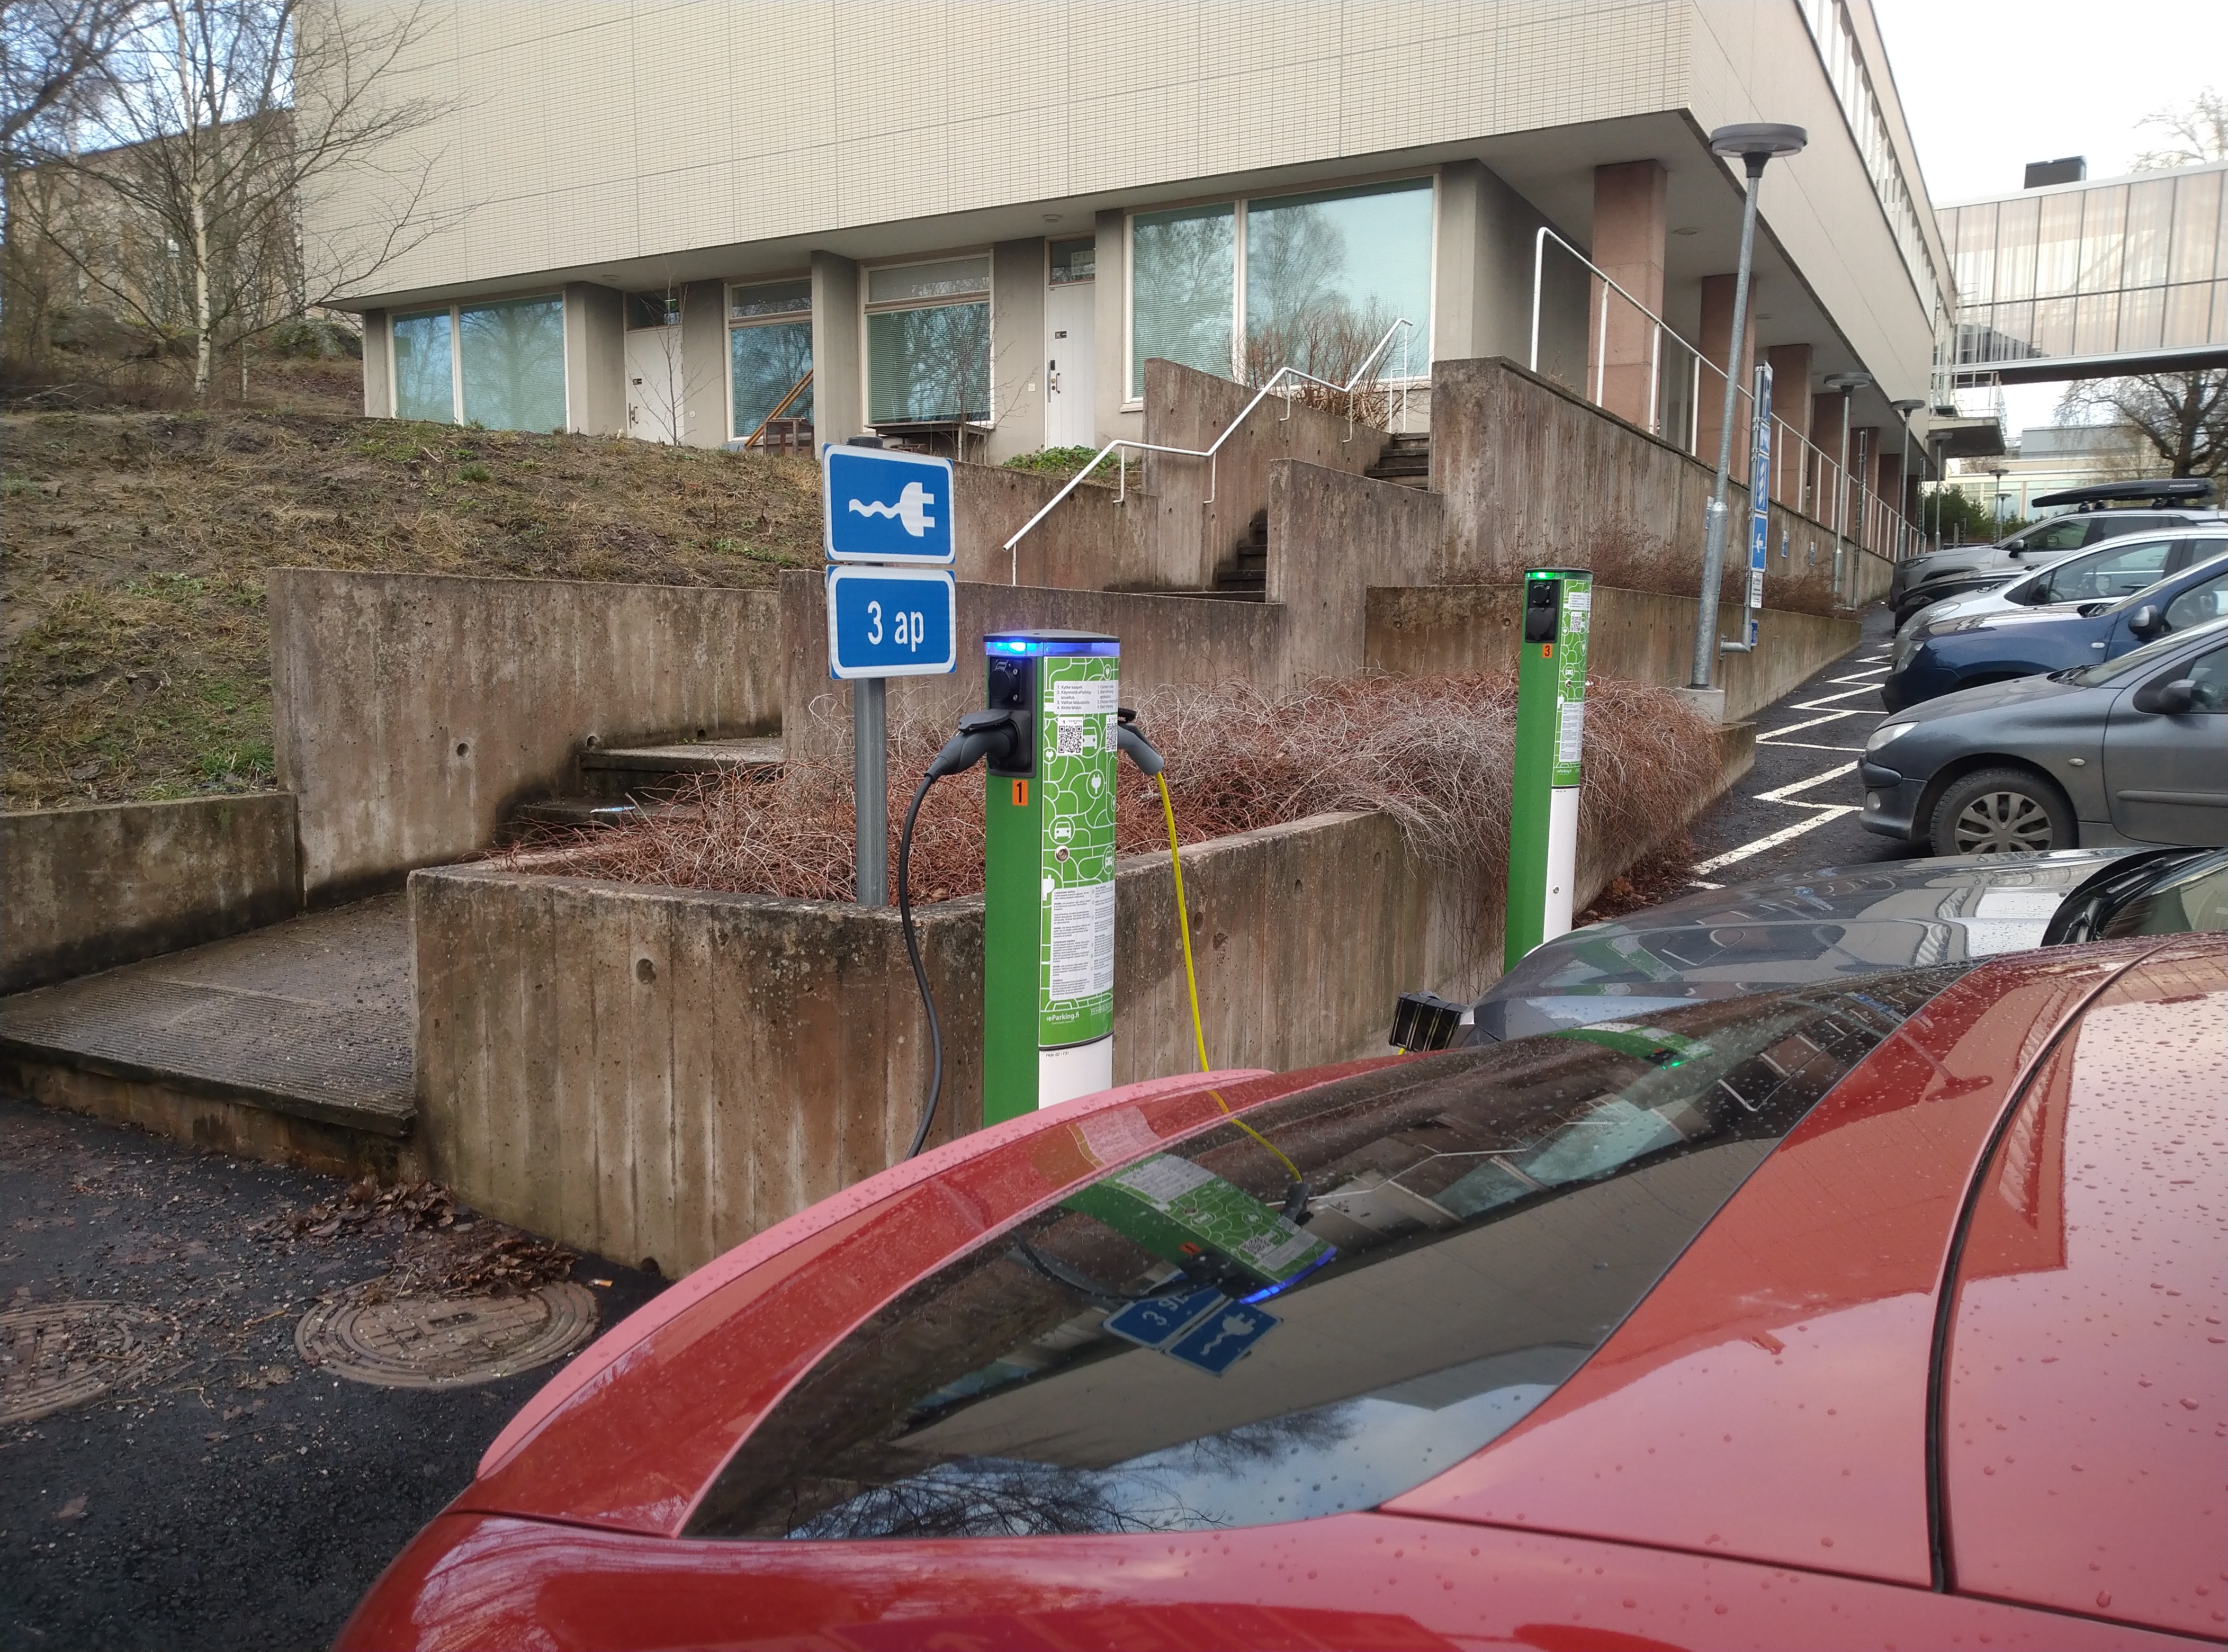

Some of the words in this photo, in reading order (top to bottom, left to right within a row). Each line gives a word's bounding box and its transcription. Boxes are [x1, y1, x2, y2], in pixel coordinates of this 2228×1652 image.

[867, 600, 883, 645] 3
[894, 611, 924, 653] ap
[1544, 645, 1550, 657] 3
[1017, 782, 1022, 803] 1
